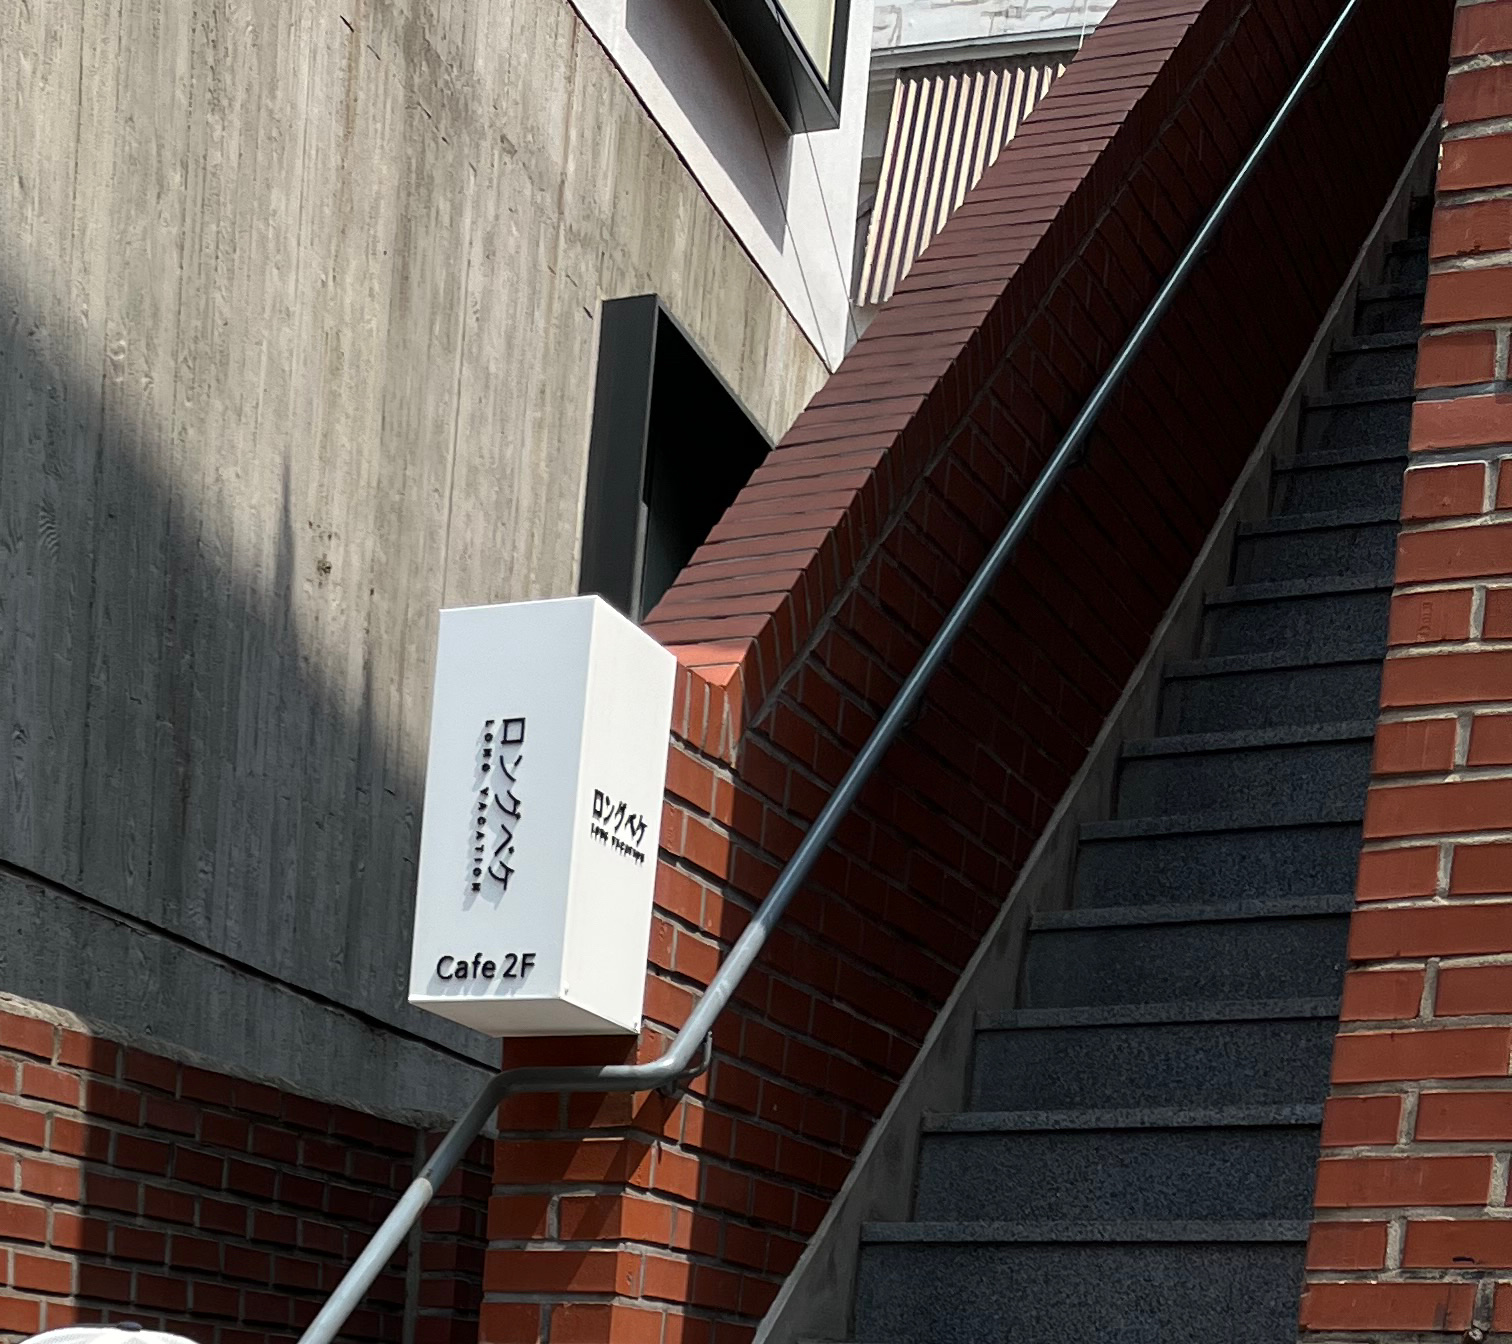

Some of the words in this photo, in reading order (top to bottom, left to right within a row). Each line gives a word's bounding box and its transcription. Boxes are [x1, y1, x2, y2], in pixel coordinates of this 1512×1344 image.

[481, 719, 495, 772] LONG
[471, 787, 490, 893] VACATION
[436, 952, 497, 980] Cafe
[503, 952, 536, 979] 2F
